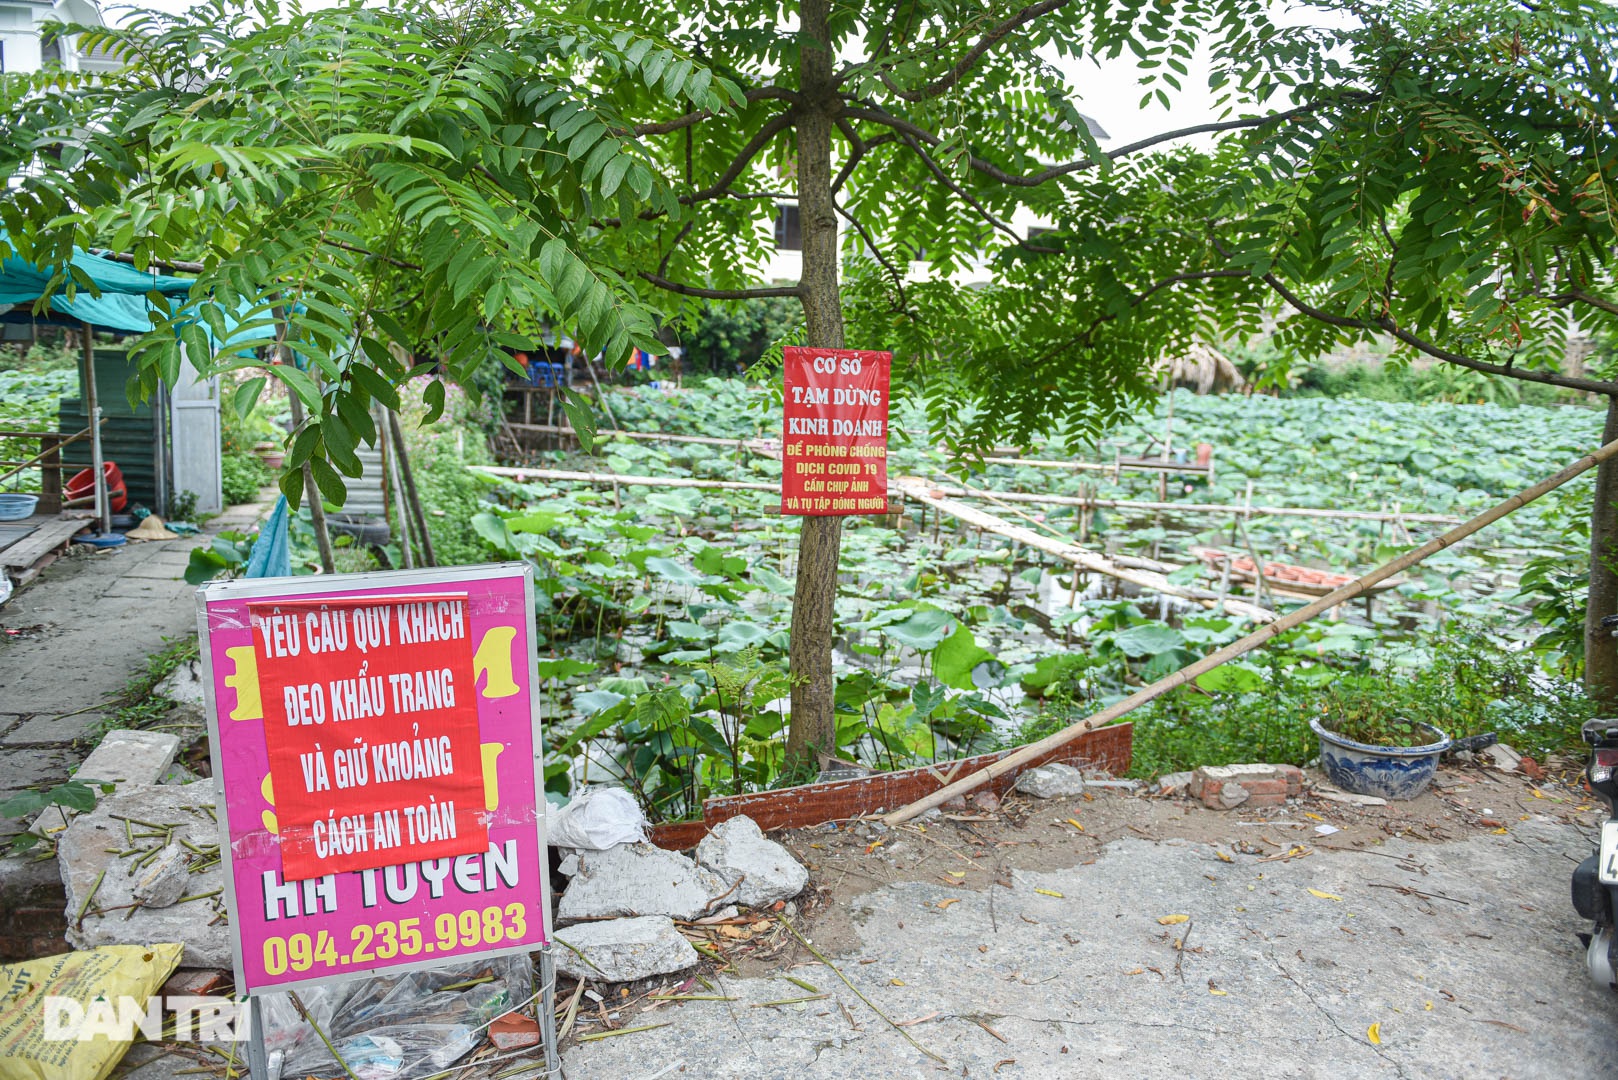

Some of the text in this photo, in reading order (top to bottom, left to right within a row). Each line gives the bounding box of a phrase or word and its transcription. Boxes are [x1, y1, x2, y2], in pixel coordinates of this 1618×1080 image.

[814, 352, 862, 375] CƠ SỞ
[792, 384, 881, 408] TẠM DỪNG
[788, 418, 882, 436] KINH DOANH
[849, 442, 885, 458] CHỐNG
[796, 462, 878, 476] DỊCH COVID 19
[804, 477, 869, 494] CẤM CHỤP ẢNH
[787, 496, 799, 509] VÀ
[259, 607, 301, 658] YÊU
[283, 682, 326, 726] ĐEO
[329, 660, 385, 722] KHẨU
[389, 668, 455, 713] TRANG
[300, 743, 330, 793] VÀ
[333, 737, 369, 789] GIỮ
[371, 722, 454, 784] KHOẢNG
[312, 795, 457, 859] CÁCH AN TOÀN
[263, 902, 527, 976] 094.235.9983
